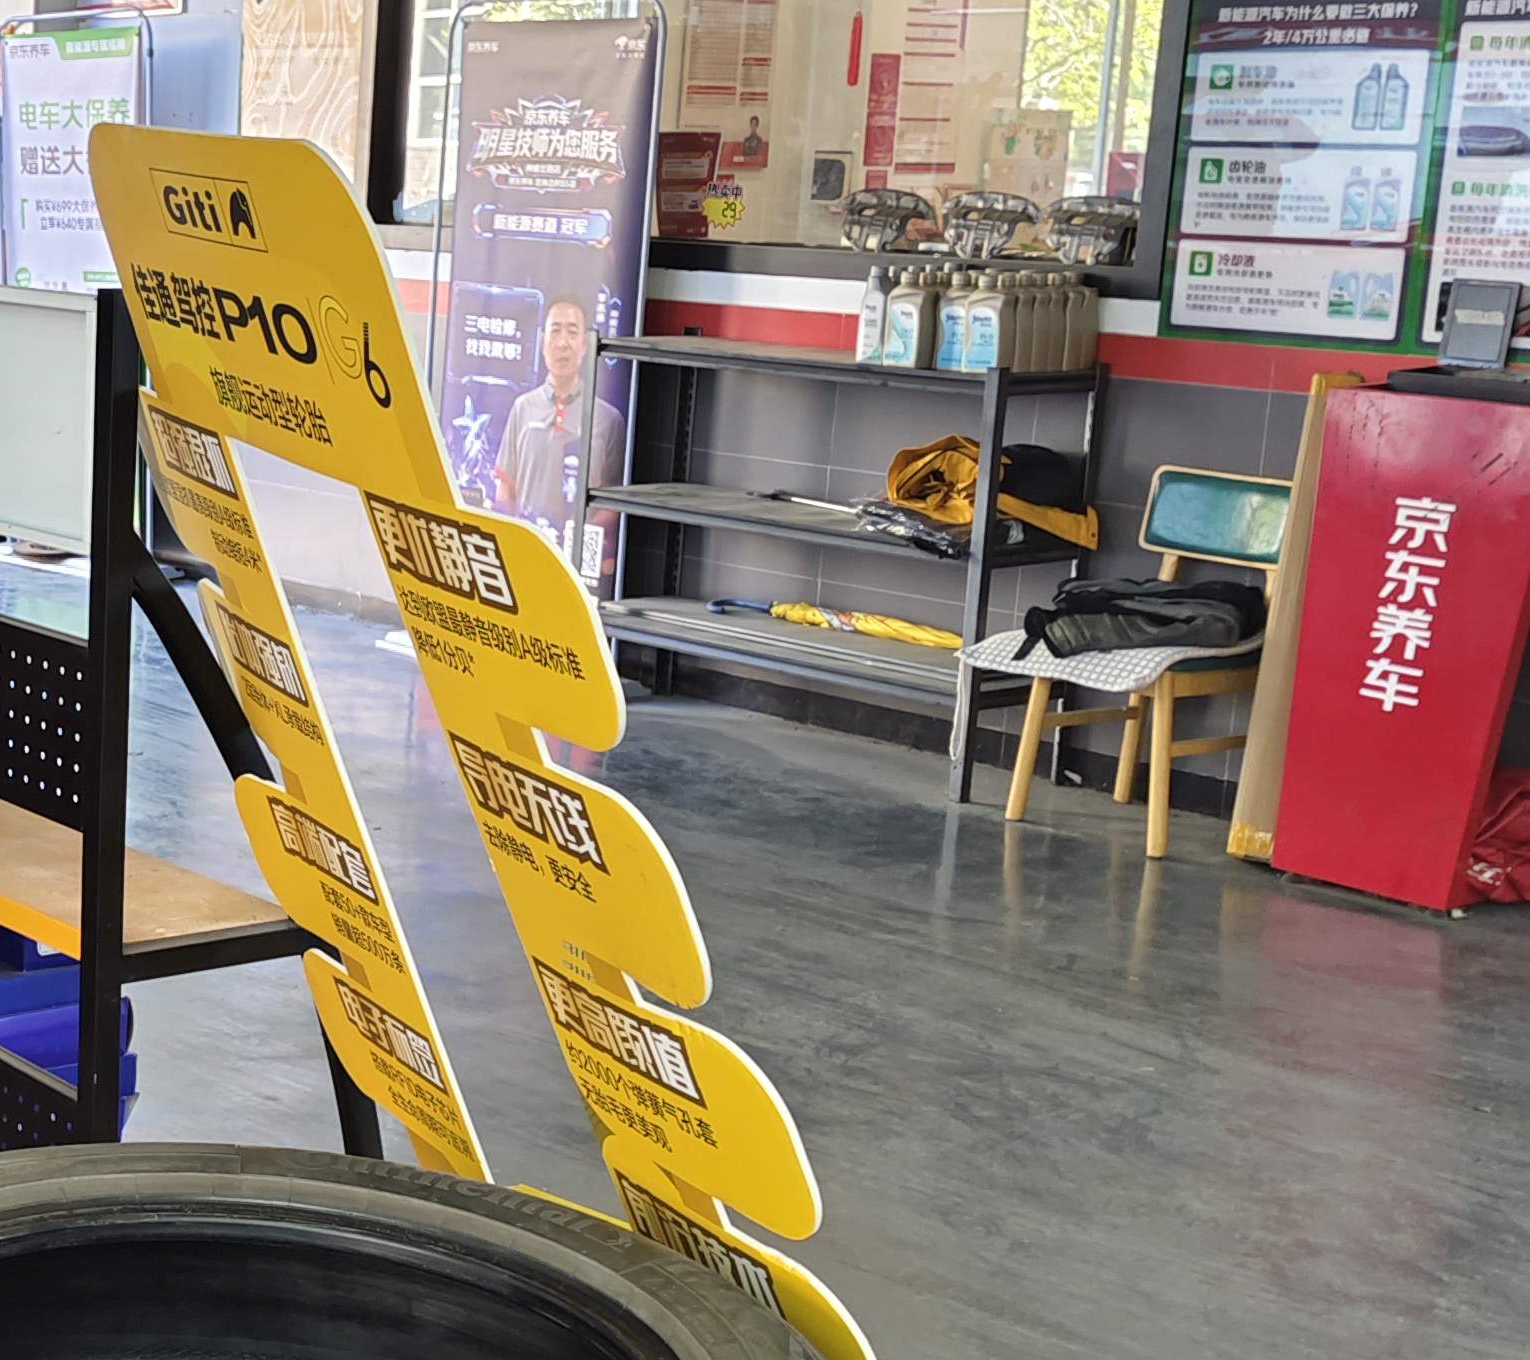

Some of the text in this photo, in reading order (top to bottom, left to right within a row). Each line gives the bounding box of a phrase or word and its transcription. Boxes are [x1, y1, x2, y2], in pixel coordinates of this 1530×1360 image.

[19, 97, 131, 131] 电车大保养
[523, 109, 571, 126] 京东养车
[20, 145, 91, 177] 赠送大
[473, 127, 619, 164] 明星技师为您服务
[1229, 159, 1267, 175] 齿轮油
[163, 185, 223, 233] Giti
[560, 218, 589, 236] 冠军
[1217, 253, 1256, 268] 冷却液
[209, 365, 334, 448] 旗舰运动型轮胎
[370, 498, 514, 607] 更优静音
[1359, 495, 1457, 713] 京东养车
[537, 964, 701, 1102] 更高颜值
